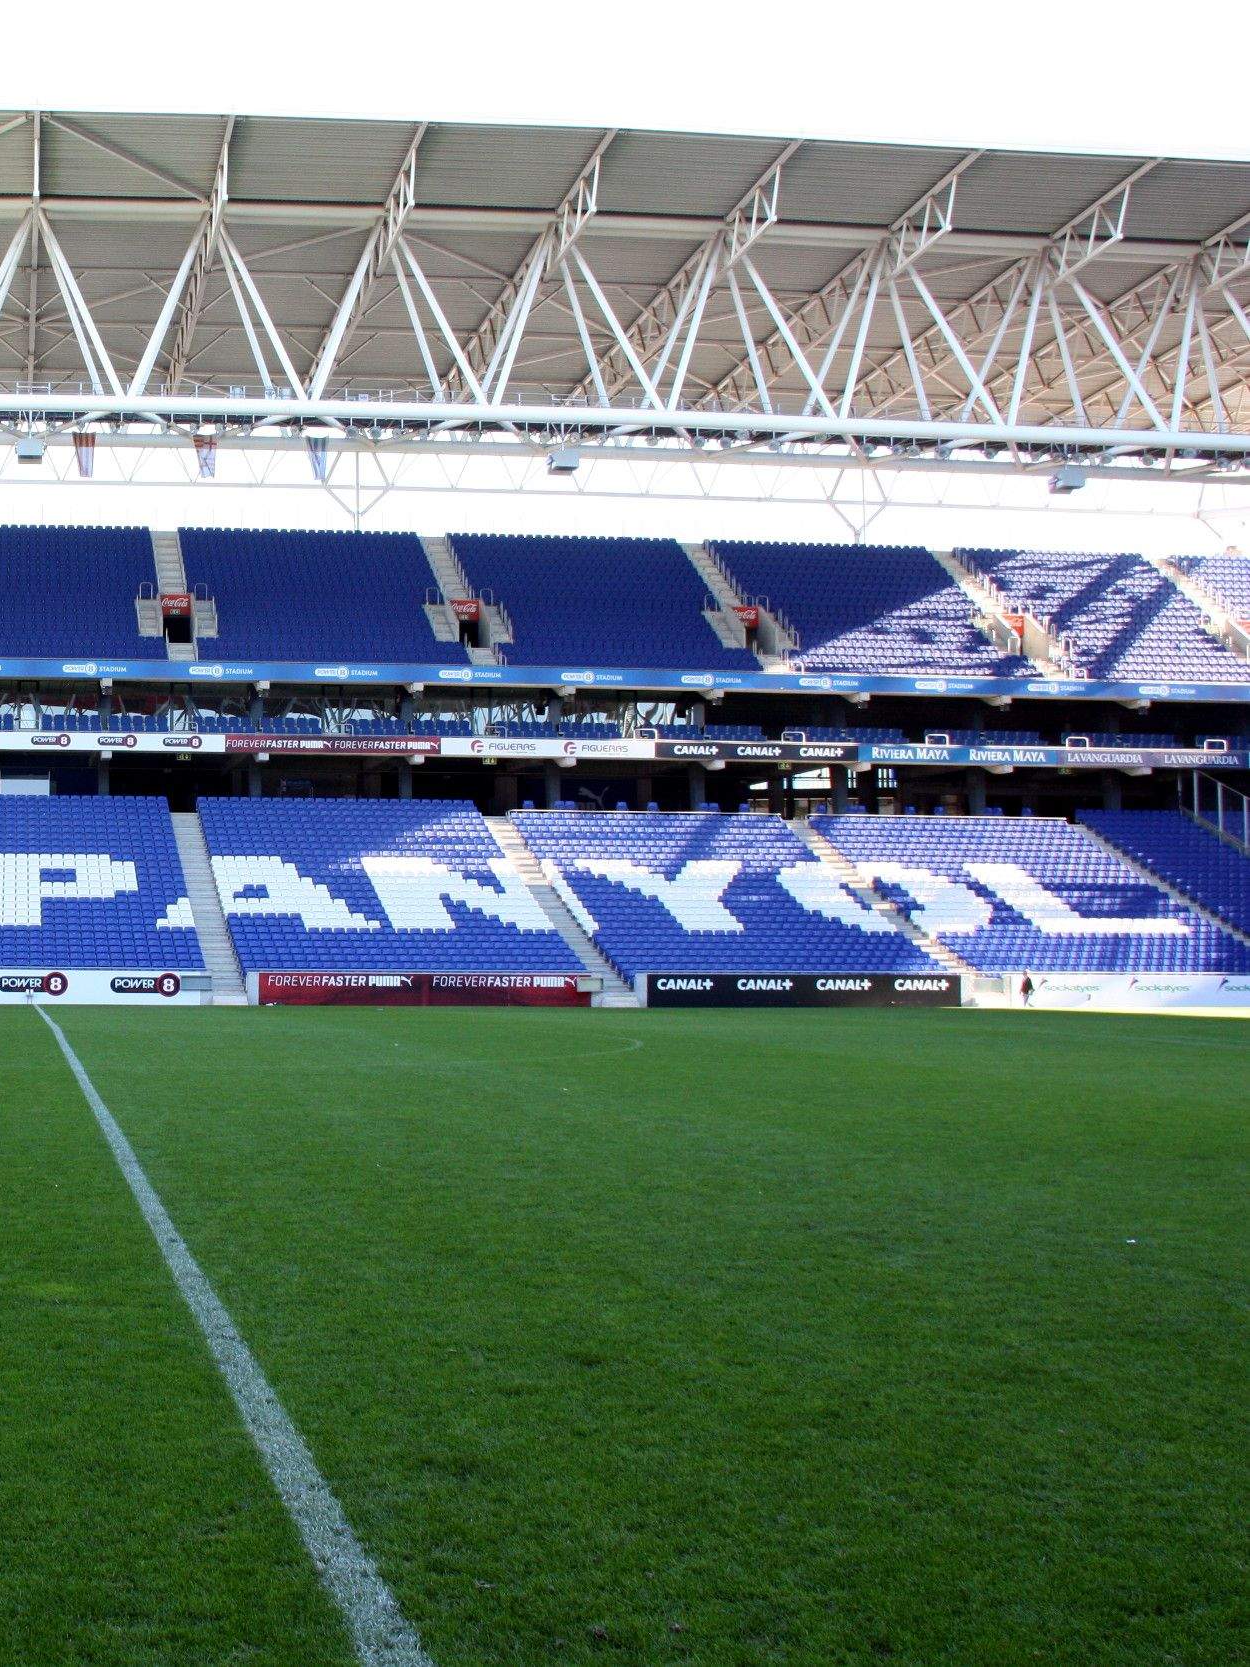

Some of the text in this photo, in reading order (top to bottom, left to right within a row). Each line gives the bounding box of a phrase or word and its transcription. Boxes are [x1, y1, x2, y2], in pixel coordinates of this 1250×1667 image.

[674, 745, 719, 756] CANAL+
[737, 746, 782, 756] CANAL+
[800, 747, 844, 758] CANAL+
[872, 746, 950, 760] RIVIERA MAYA
[969, 749, 1046, 762] RIVIERA MAYA
[368, 975, 400, 987] PUMA
[533, 976, 565, 987] PUMA
[657, 978, 713, 990] CANAL+
[737, 978, 793, 991] CANAL+
[816, 978, 872, 991] CANAL+
[894, 979, 949, 991] CANAL+
